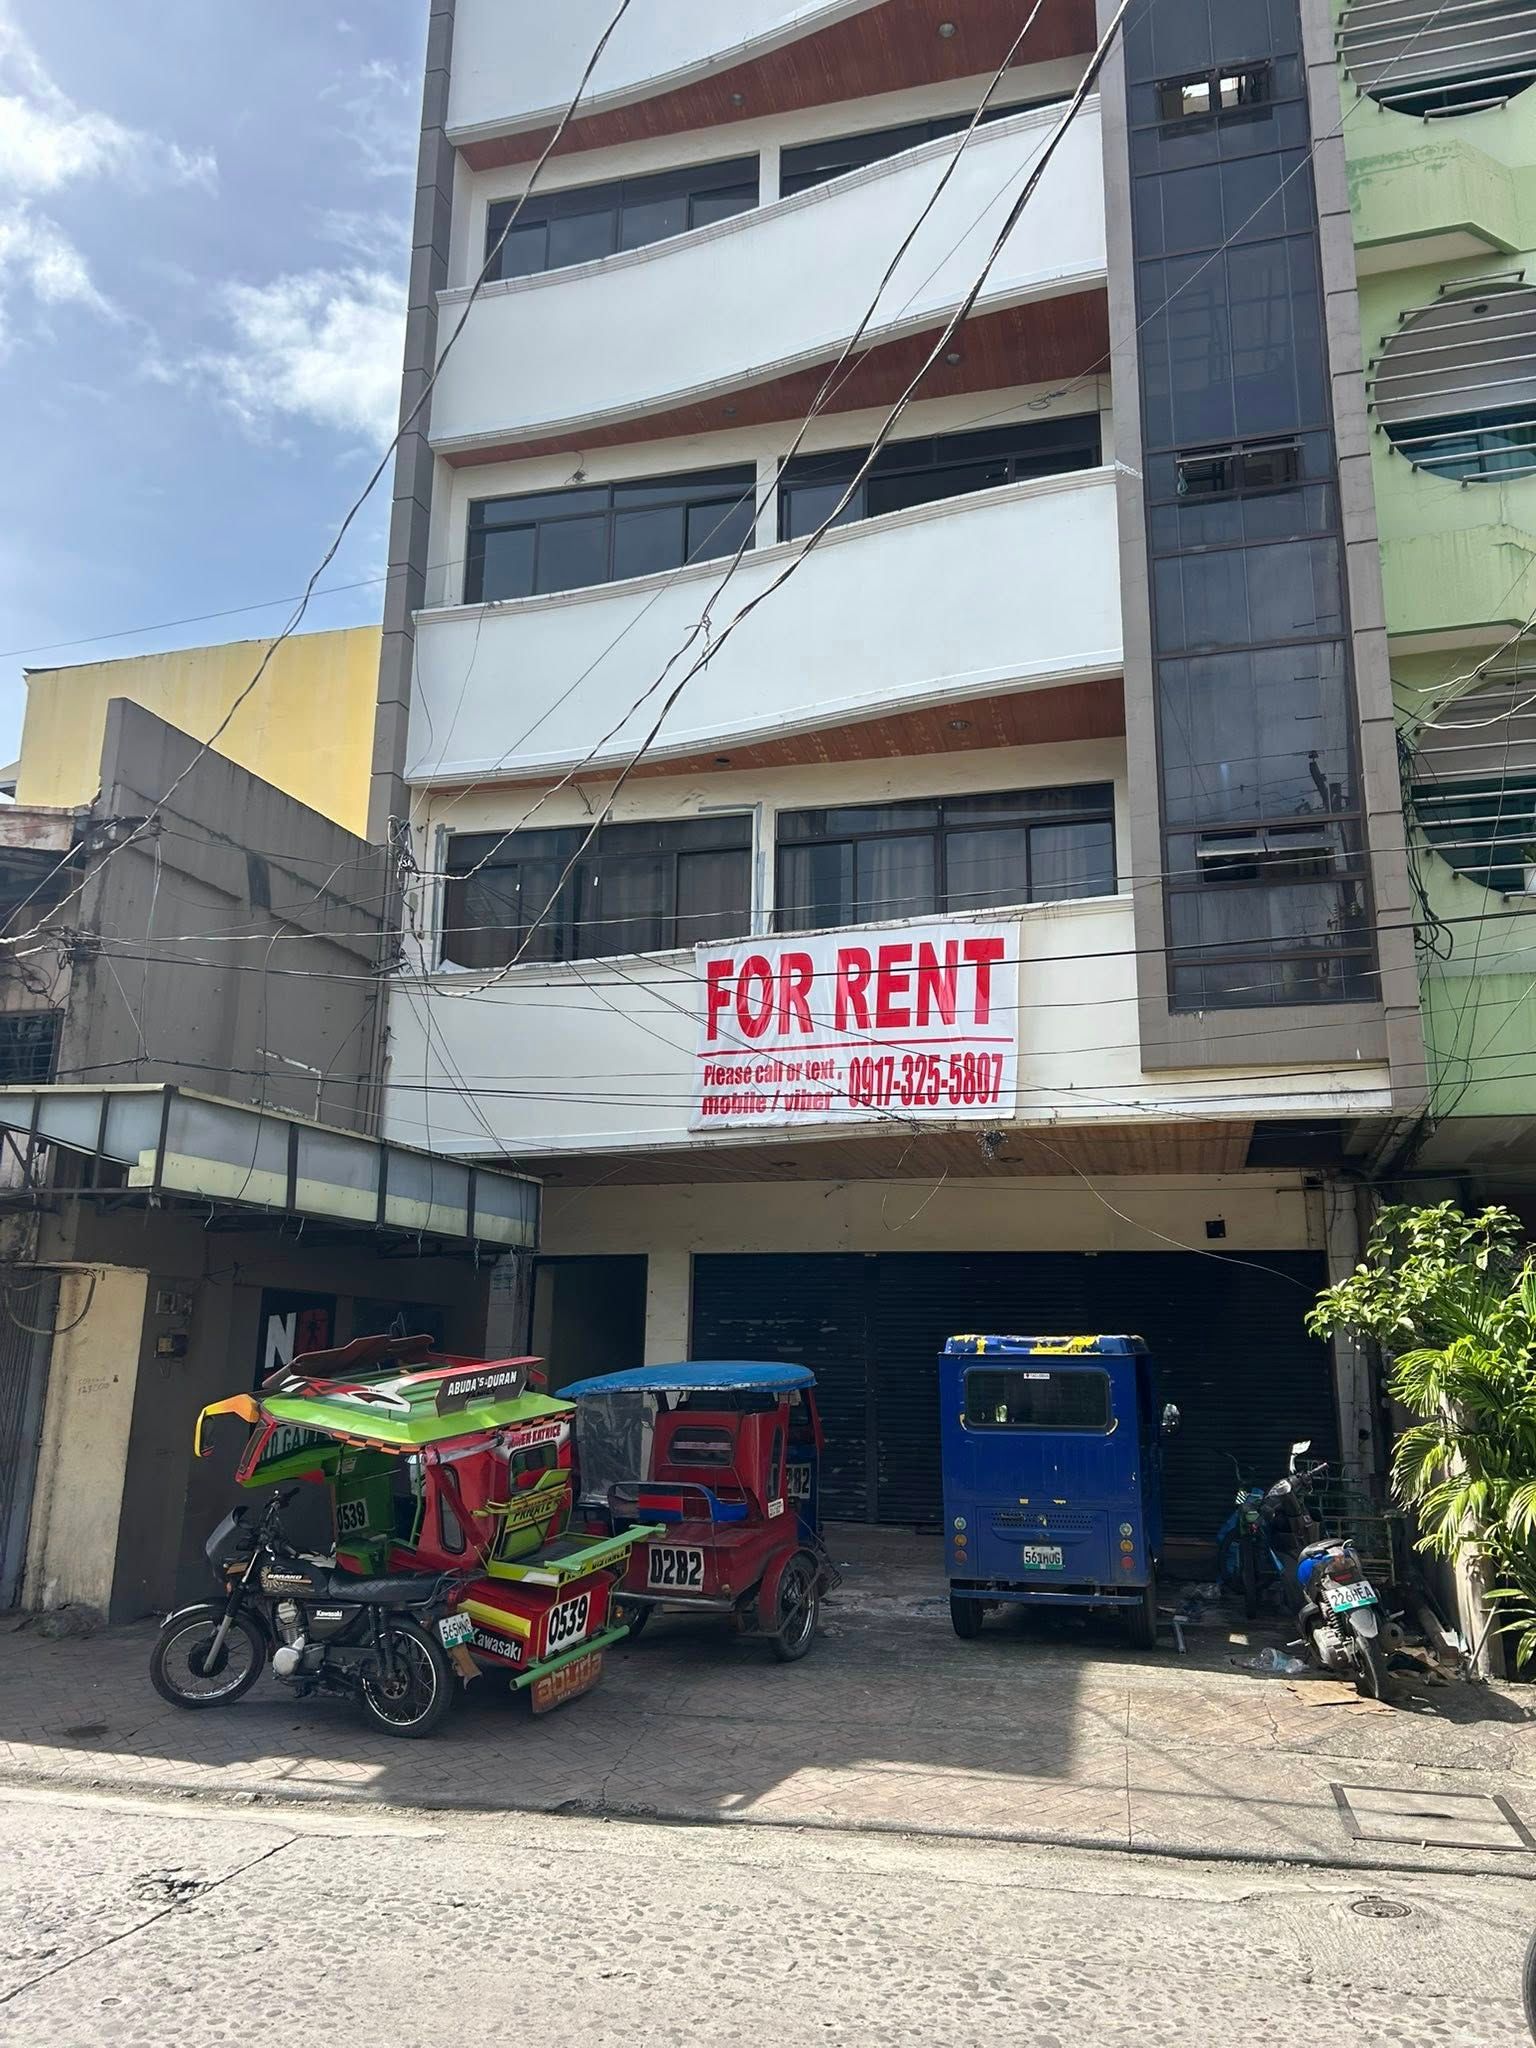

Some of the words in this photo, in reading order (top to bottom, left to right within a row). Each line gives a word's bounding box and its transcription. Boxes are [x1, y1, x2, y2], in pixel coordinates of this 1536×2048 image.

[707, 952, 814, 1041] FOR
[834, 938, 1005, 1032] RENT
[704, 1064, 752, 1087] Please
[755, 1060, 783, 1084] call
[786, 1062, 802, 1081] or
[849, 1051, 1003, 1108] 0917-325-5807
[702, 1091, 767, 1115] mobile
[771, 1089, 780, 1113] /
[784, 1089, 833, 1112] viber
[447, 1377, 485, 1397] ABUDA'S
[487, 1371, 518, 1388] DURAN
[650, 1548, 702, 1586] 0282
[1330, 1585, 1374, 1607] 226HEA
[316, 1609, 343, 1617] Kawasaki
[549, 1594, 588, 1646] 0539
